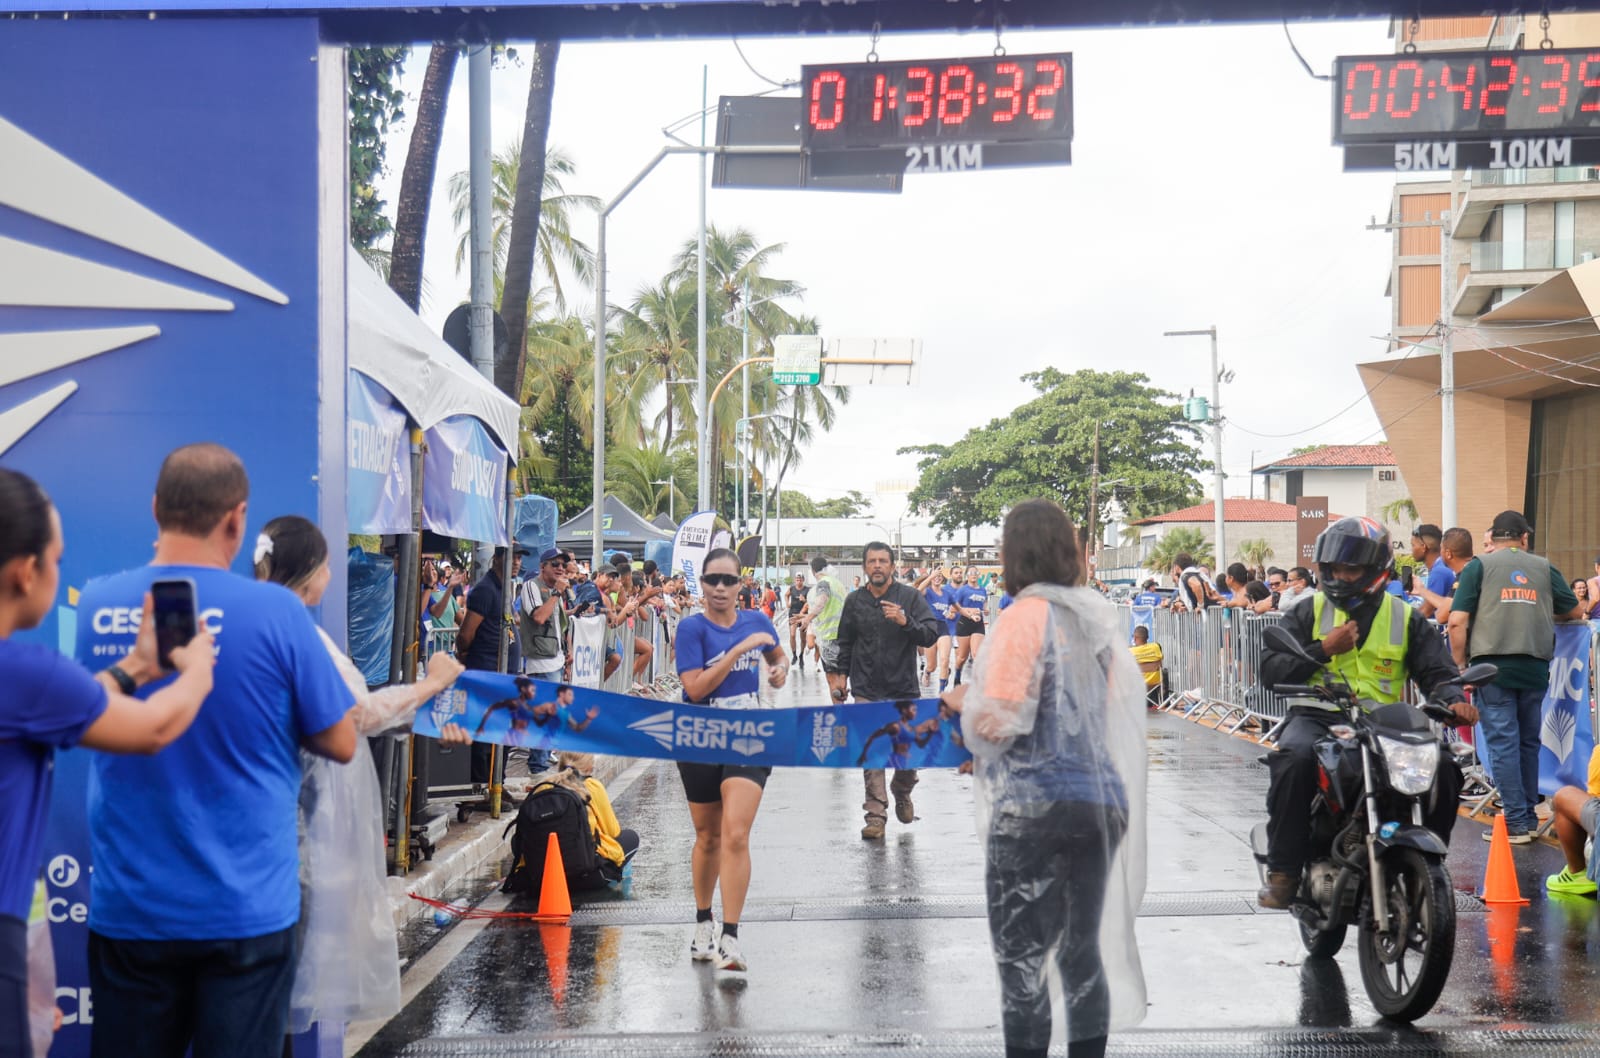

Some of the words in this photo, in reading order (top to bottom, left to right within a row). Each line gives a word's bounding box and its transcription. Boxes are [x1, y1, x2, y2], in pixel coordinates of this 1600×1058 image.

[810, 60, 1063, 130] 01:38:32
[905, 144, 982, 173] 21KM
[1394, 142, 1457, 170] 5KM
[1489, 138, 1571, 169] 10KM
[680, 533, 708, 543] CRIME
[682, 525, 709, 535] AMERICAN
[1501, 587, 1537, 600] ATTIVA
[93, 607, 225, 635] CESC
[676, 715, 775, 737] CESMAC
[676, 731, 727, 749] RUN
